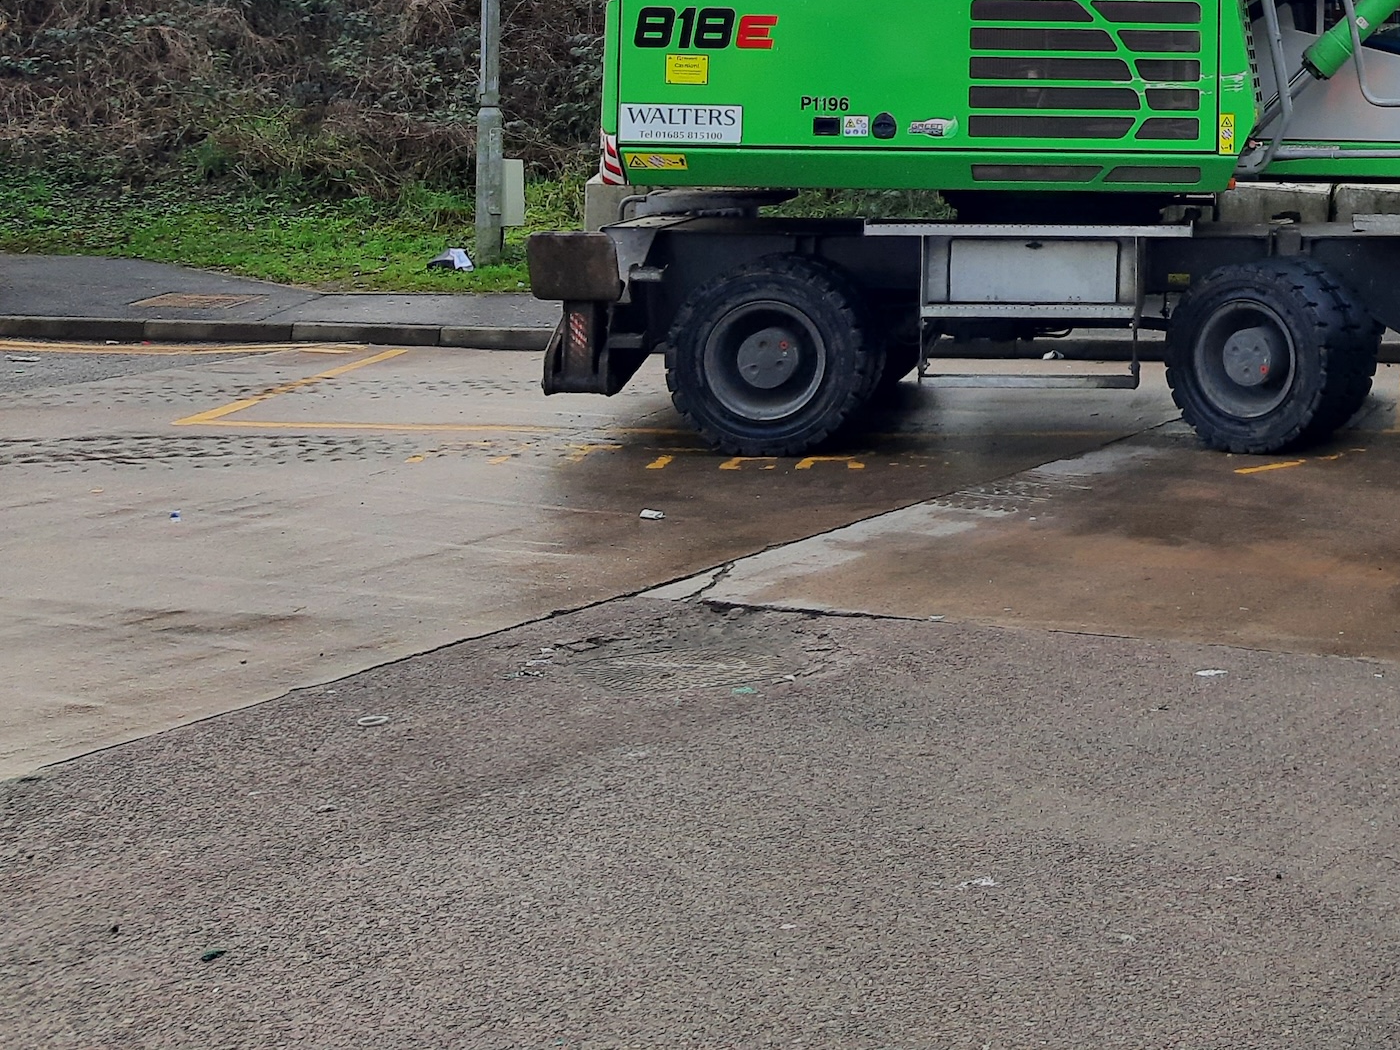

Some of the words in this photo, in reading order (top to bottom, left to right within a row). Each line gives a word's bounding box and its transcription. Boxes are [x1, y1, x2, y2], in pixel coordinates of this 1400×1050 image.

[633, 6, 778, 50] 818E
[800, 96, 849, 111] P1196
[627, 107, 736, 126] WALTERS
[639, 130, 653, 139] Tel
[655, 130, 685, 139] 01685
[687, 131, 723, 140] 815100
